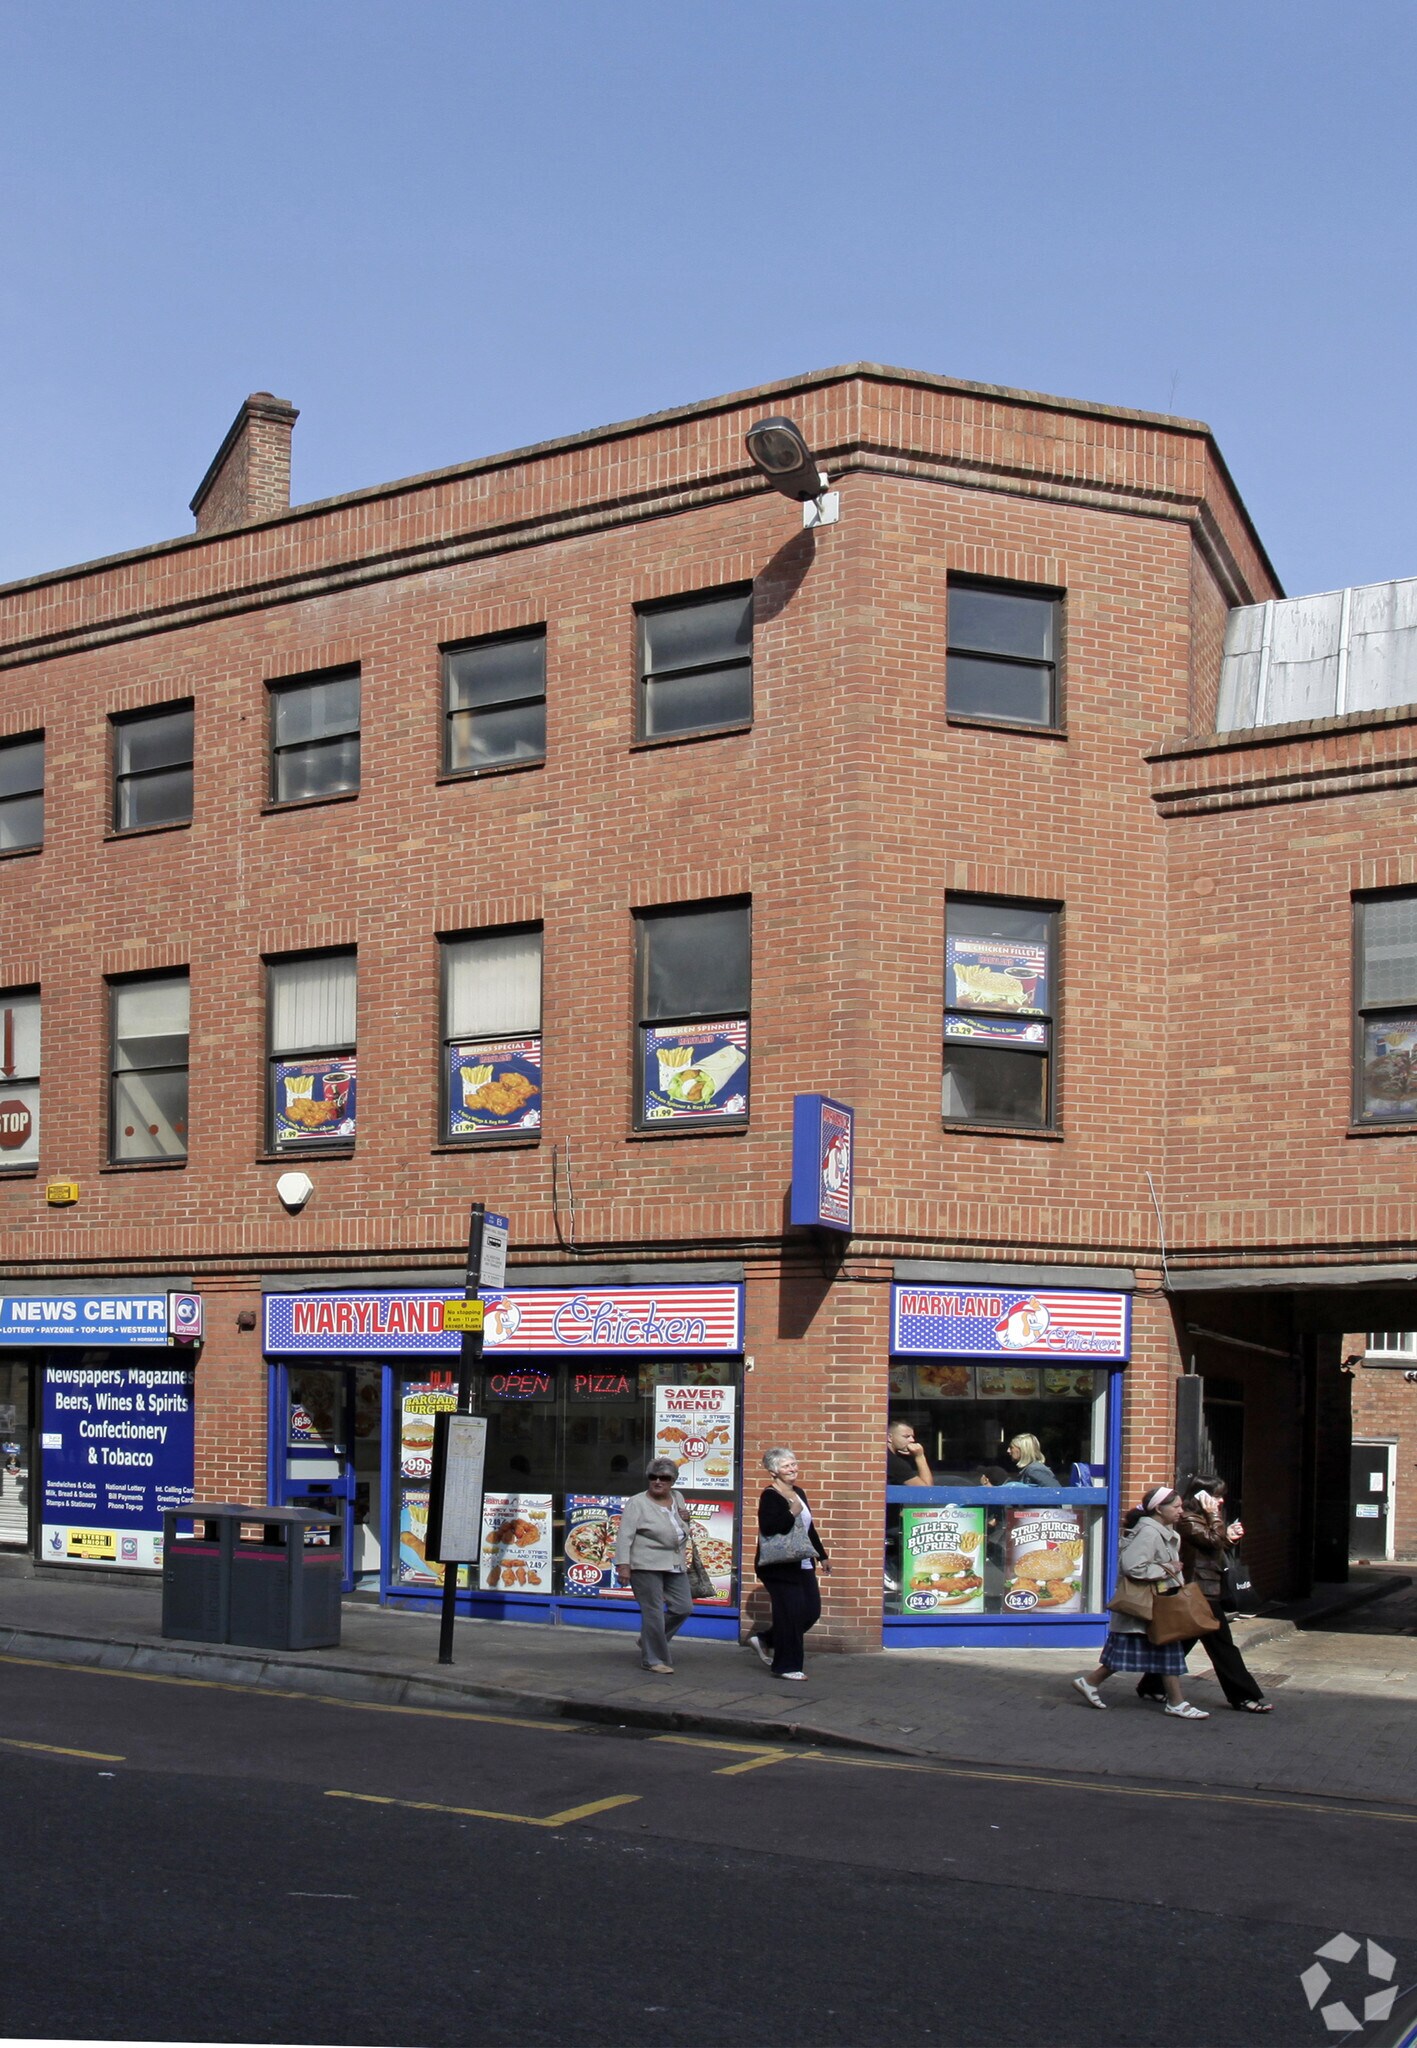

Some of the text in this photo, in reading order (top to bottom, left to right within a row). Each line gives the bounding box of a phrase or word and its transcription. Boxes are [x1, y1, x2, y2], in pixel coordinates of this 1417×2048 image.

[1011, 948, 1036, 957] FILLET
[697, 1022, 737, 1032] SPINNER
[493, 1042, 526, 1051] SPECIAL
[650, 1109, 672, 1117] £1.99
[455, 1124, 474, 1132] £1.99
[11, 1301, 77, 1321] NEWS
[900, 1294, 1004, 1318] MARYLAND
[293, 1295, 707, 1346] MARYLAND Chicken
[3, 1326, 35, 1334] LOTTERY
[40, 1326, 75, 1334] PAYZONE
[81, 1326, 114, 1334] TOP-UPS
[120, 1326, 158, 1334] WESTERN
[1046, 1327, 1120, 1352] Chicken
[46, 1368, 126, 1388] Newspapers,
[490, 1374, 550, 1393] OPEN
[575, 1374, 630, 1393] PIZZA
[664, 1389, 725, 1399] SAVER
[55, 1392, 189, 1415] Beers, Wines & Spirits
[405, 1394, 457, 1406] BARGAIN
[667, 1400, 722, 1411] MENU
[404, 1404, 458, 1415] BURGERS
[79, 1420, 168, 1444] Confectionery
[686, 1442, 704, 1453] 1.49
[88, 1447, 154, 1467] & Tobacco
[408, 1458, 432, 1474] 99p
[46, 1480, 97, 1490] Sandwiches & Cobs
[105, 1483, 146, 1493] National Lottery
[164, 1486, 182, 1494] Calling
[45, 1489, 58, 1497] Milk,
[58, 1490, 73, 1498] Bread
[78, 1490, 98, 1499] Snacks
[108, 1492, 143, 1501] Bill Payments
[46, 1499, 65, 1508] Stamps
[70, 1501, 97, 1510] Stationery
[124, 1502, 144, 1511] Top-up
[696, 1503, 720, 1512] DEAL
[583, 1508, 608, 1517] PIZZA
[911, 1522, 958, 1537] FILLET
[1041, 1521, 1081, 1534] BURGER
[82, 1538, 105, 1546] UNION
[908, 1532, 961, 1549] BURGER
[1014, 1531, 1076, 1547] FRIES & DRINK
[912, 1541, 957, 1556] & FRIES
[572, 1568, 598, 1580] £1.99
